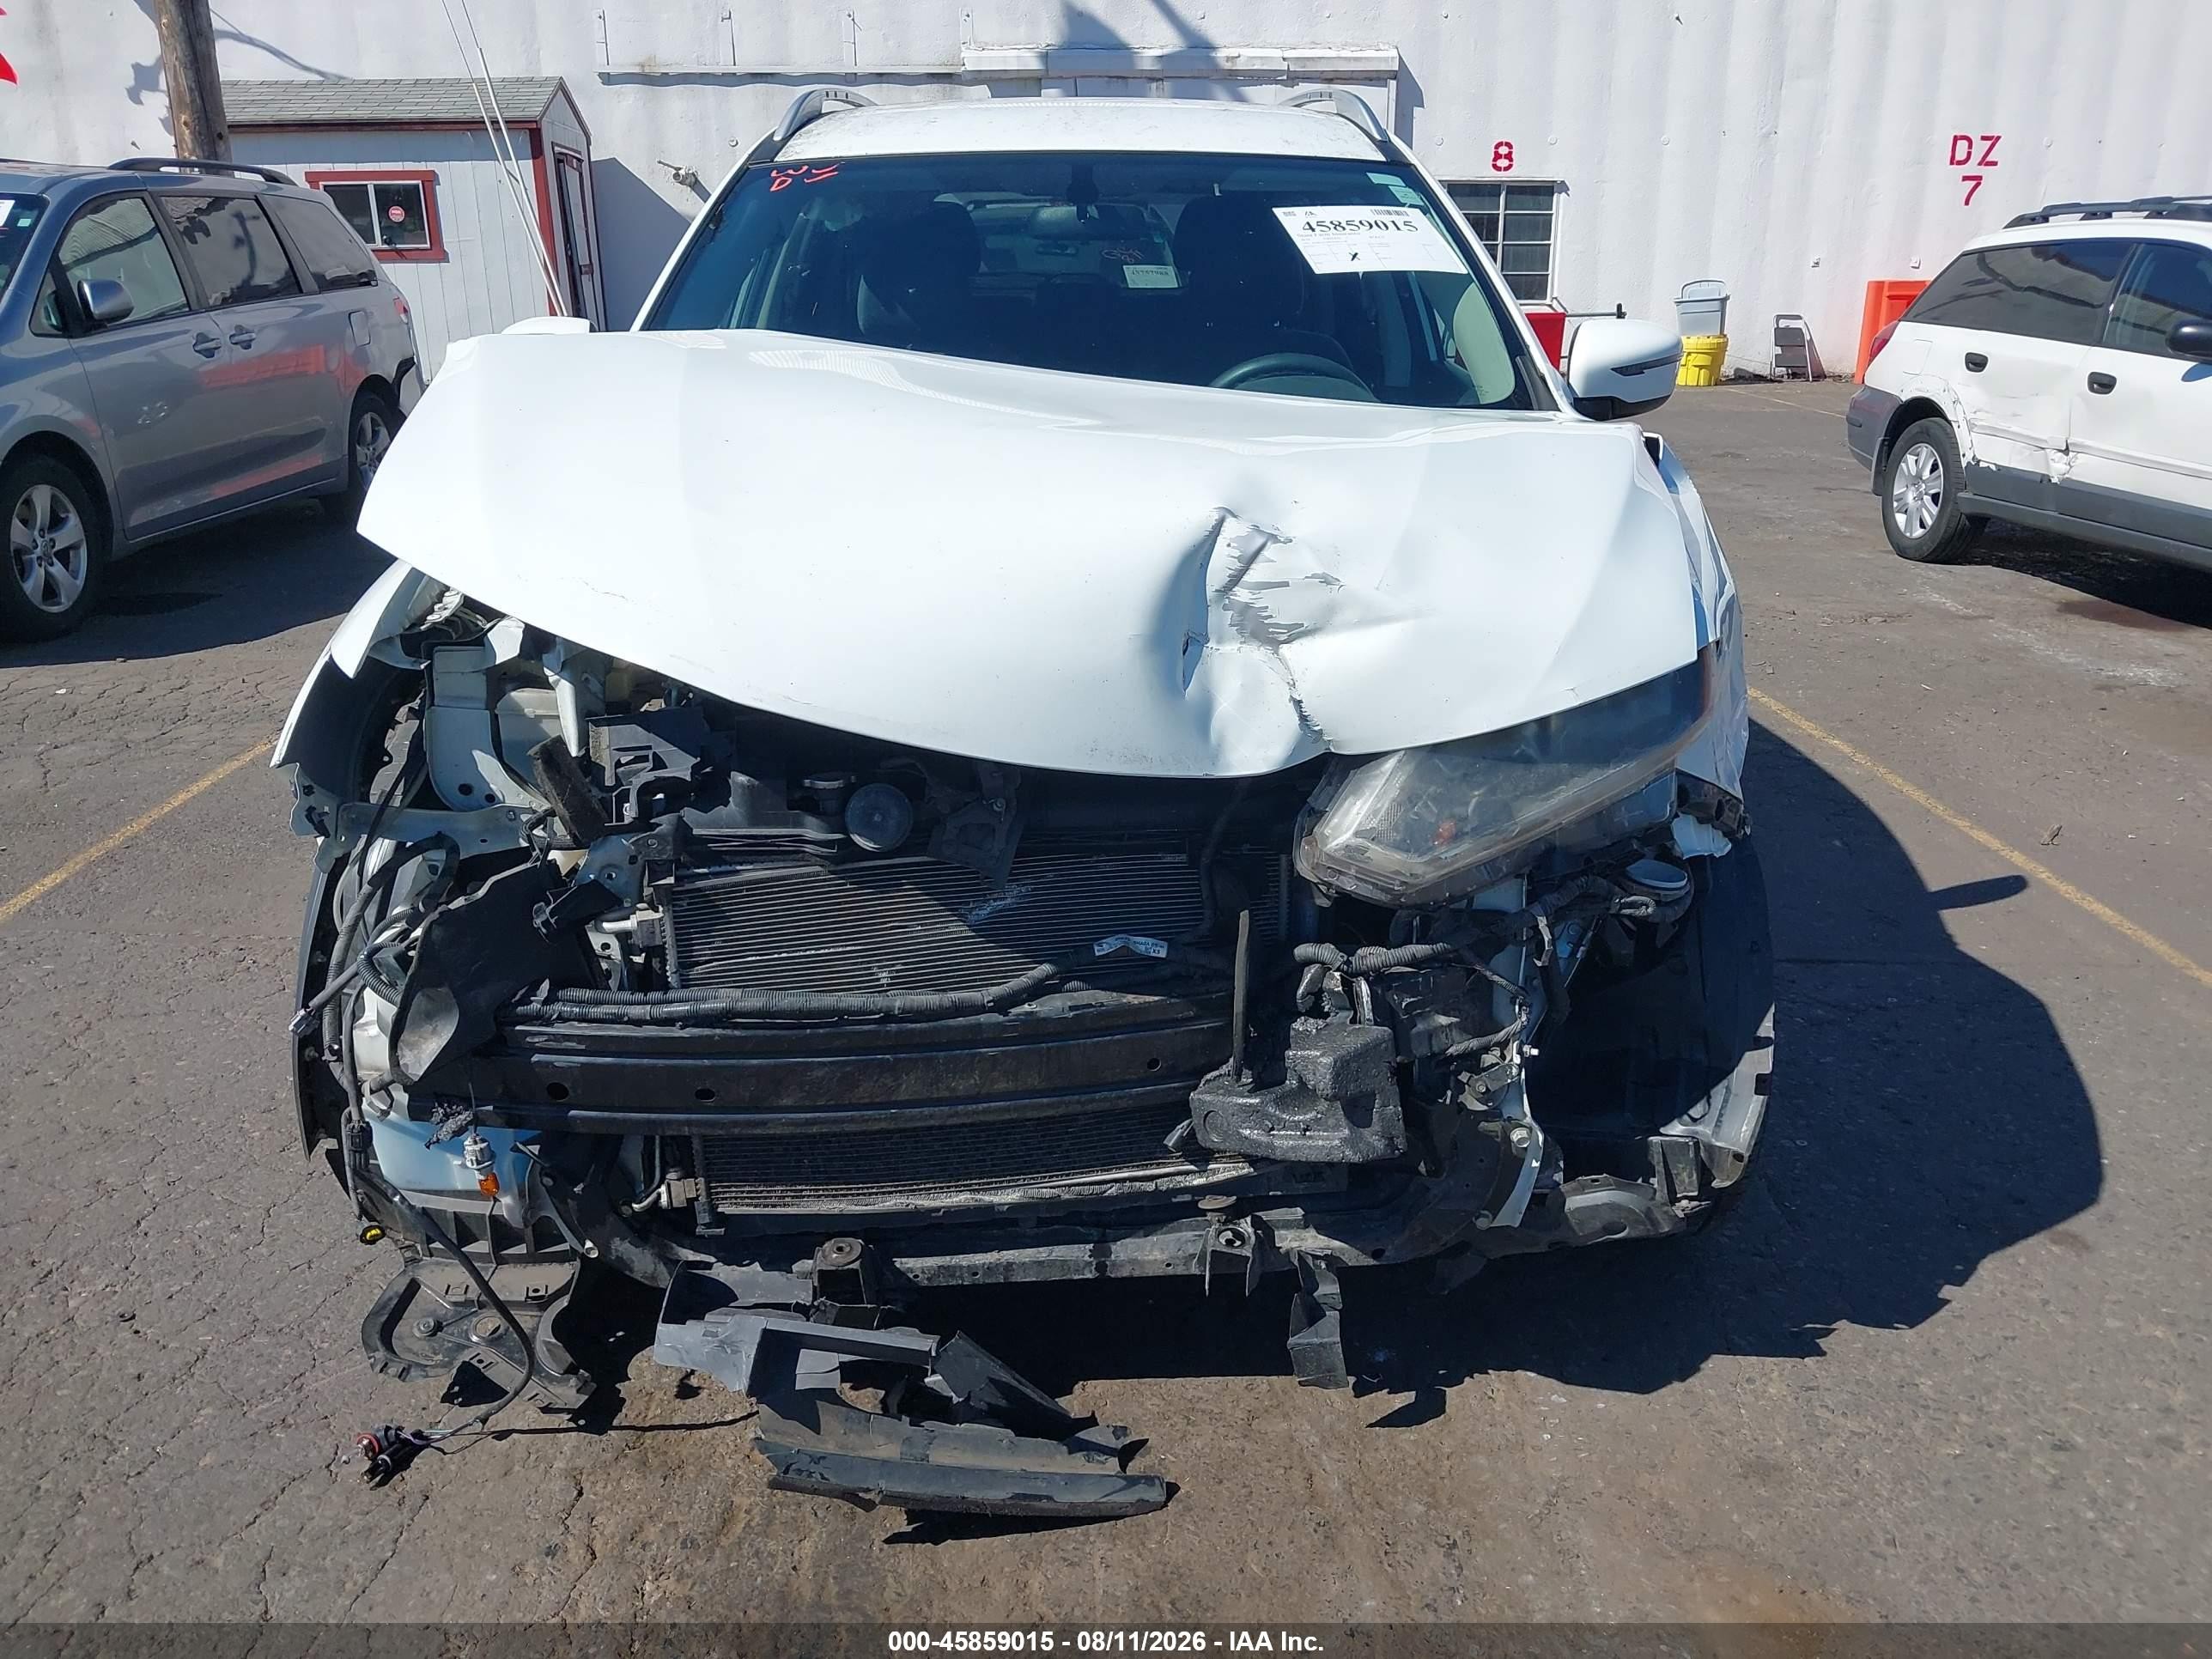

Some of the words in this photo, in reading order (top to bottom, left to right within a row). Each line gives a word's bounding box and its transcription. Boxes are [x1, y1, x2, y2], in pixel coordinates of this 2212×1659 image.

[1491, 140, 1514, 173] 8
[1949, 135, 2002, 167] DZ
[1961, 175, 1984, 206] 7
[1302, 219, 1419, 233] 45859015
